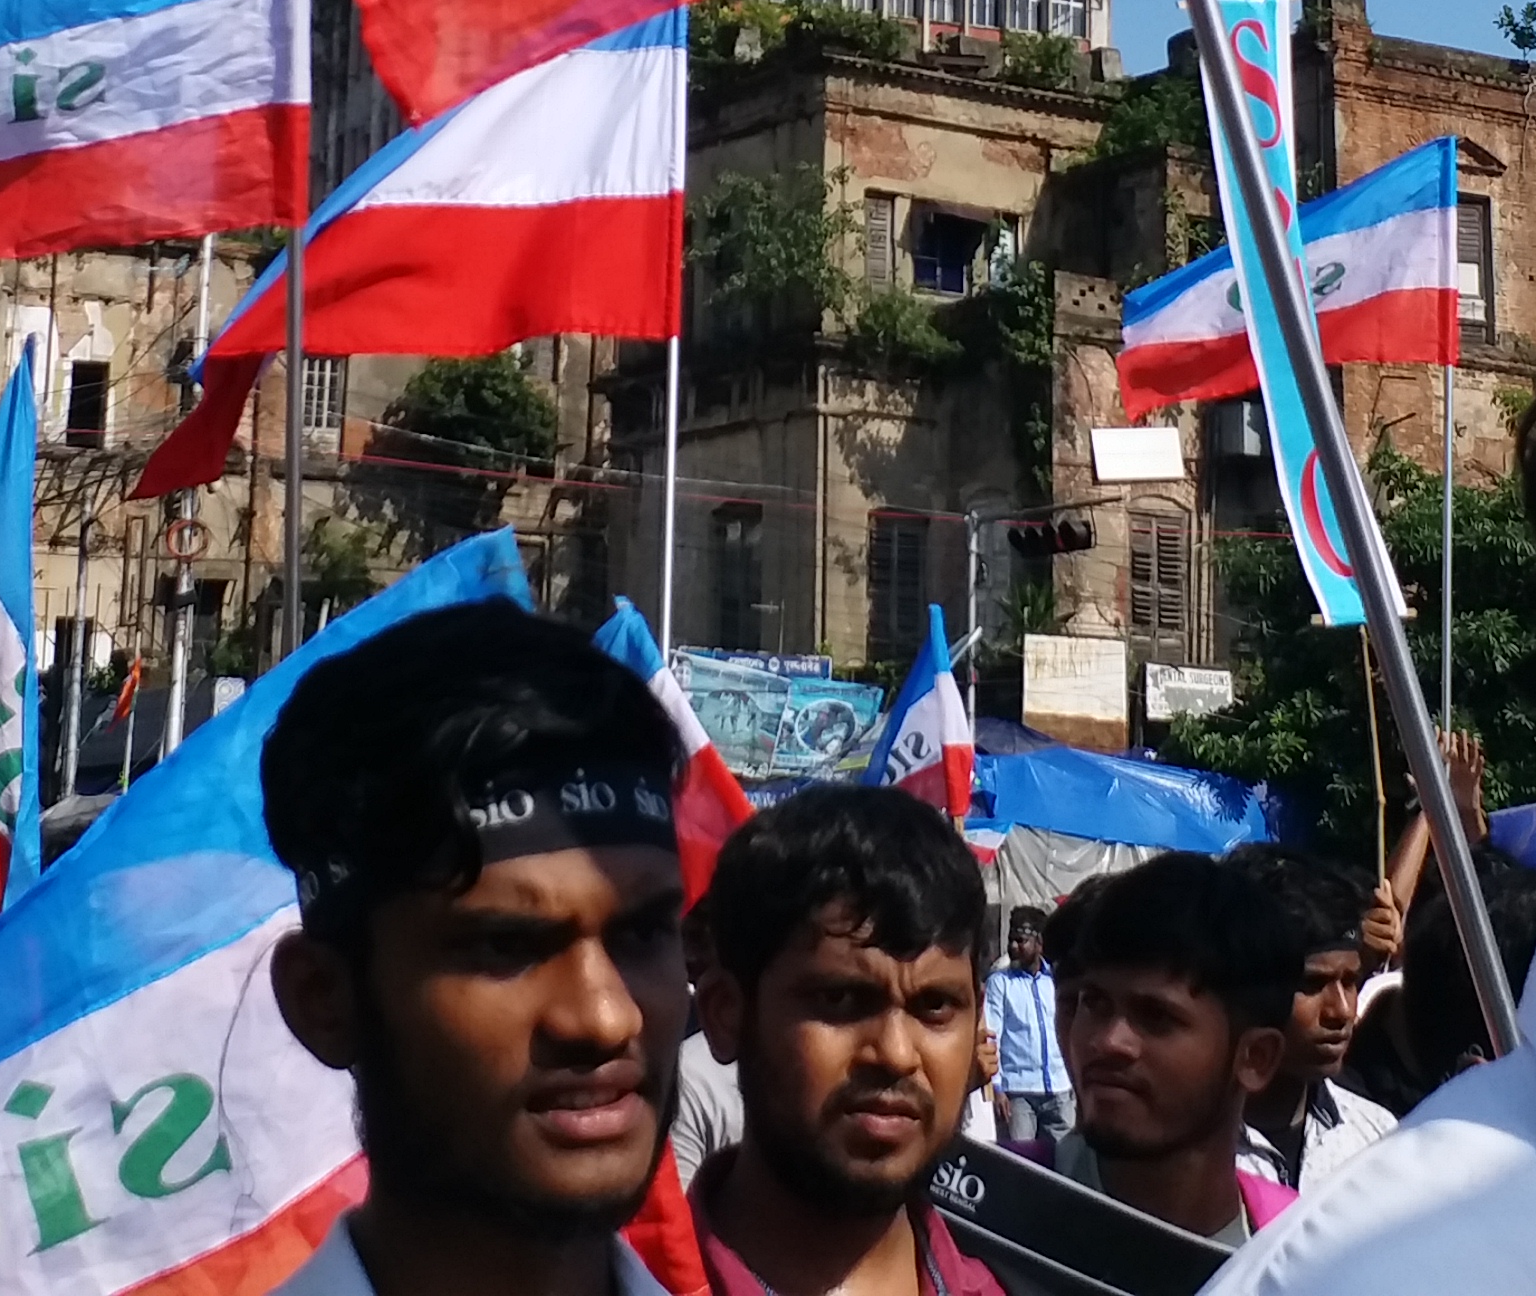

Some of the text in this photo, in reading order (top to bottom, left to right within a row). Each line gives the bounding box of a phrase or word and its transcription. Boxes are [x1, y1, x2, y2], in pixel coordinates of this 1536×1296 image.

[1189, 671, 1230, 687] SURGEONS
[561, 768, 616, 813] sio
[932, 1155, 985, 1203] sio
